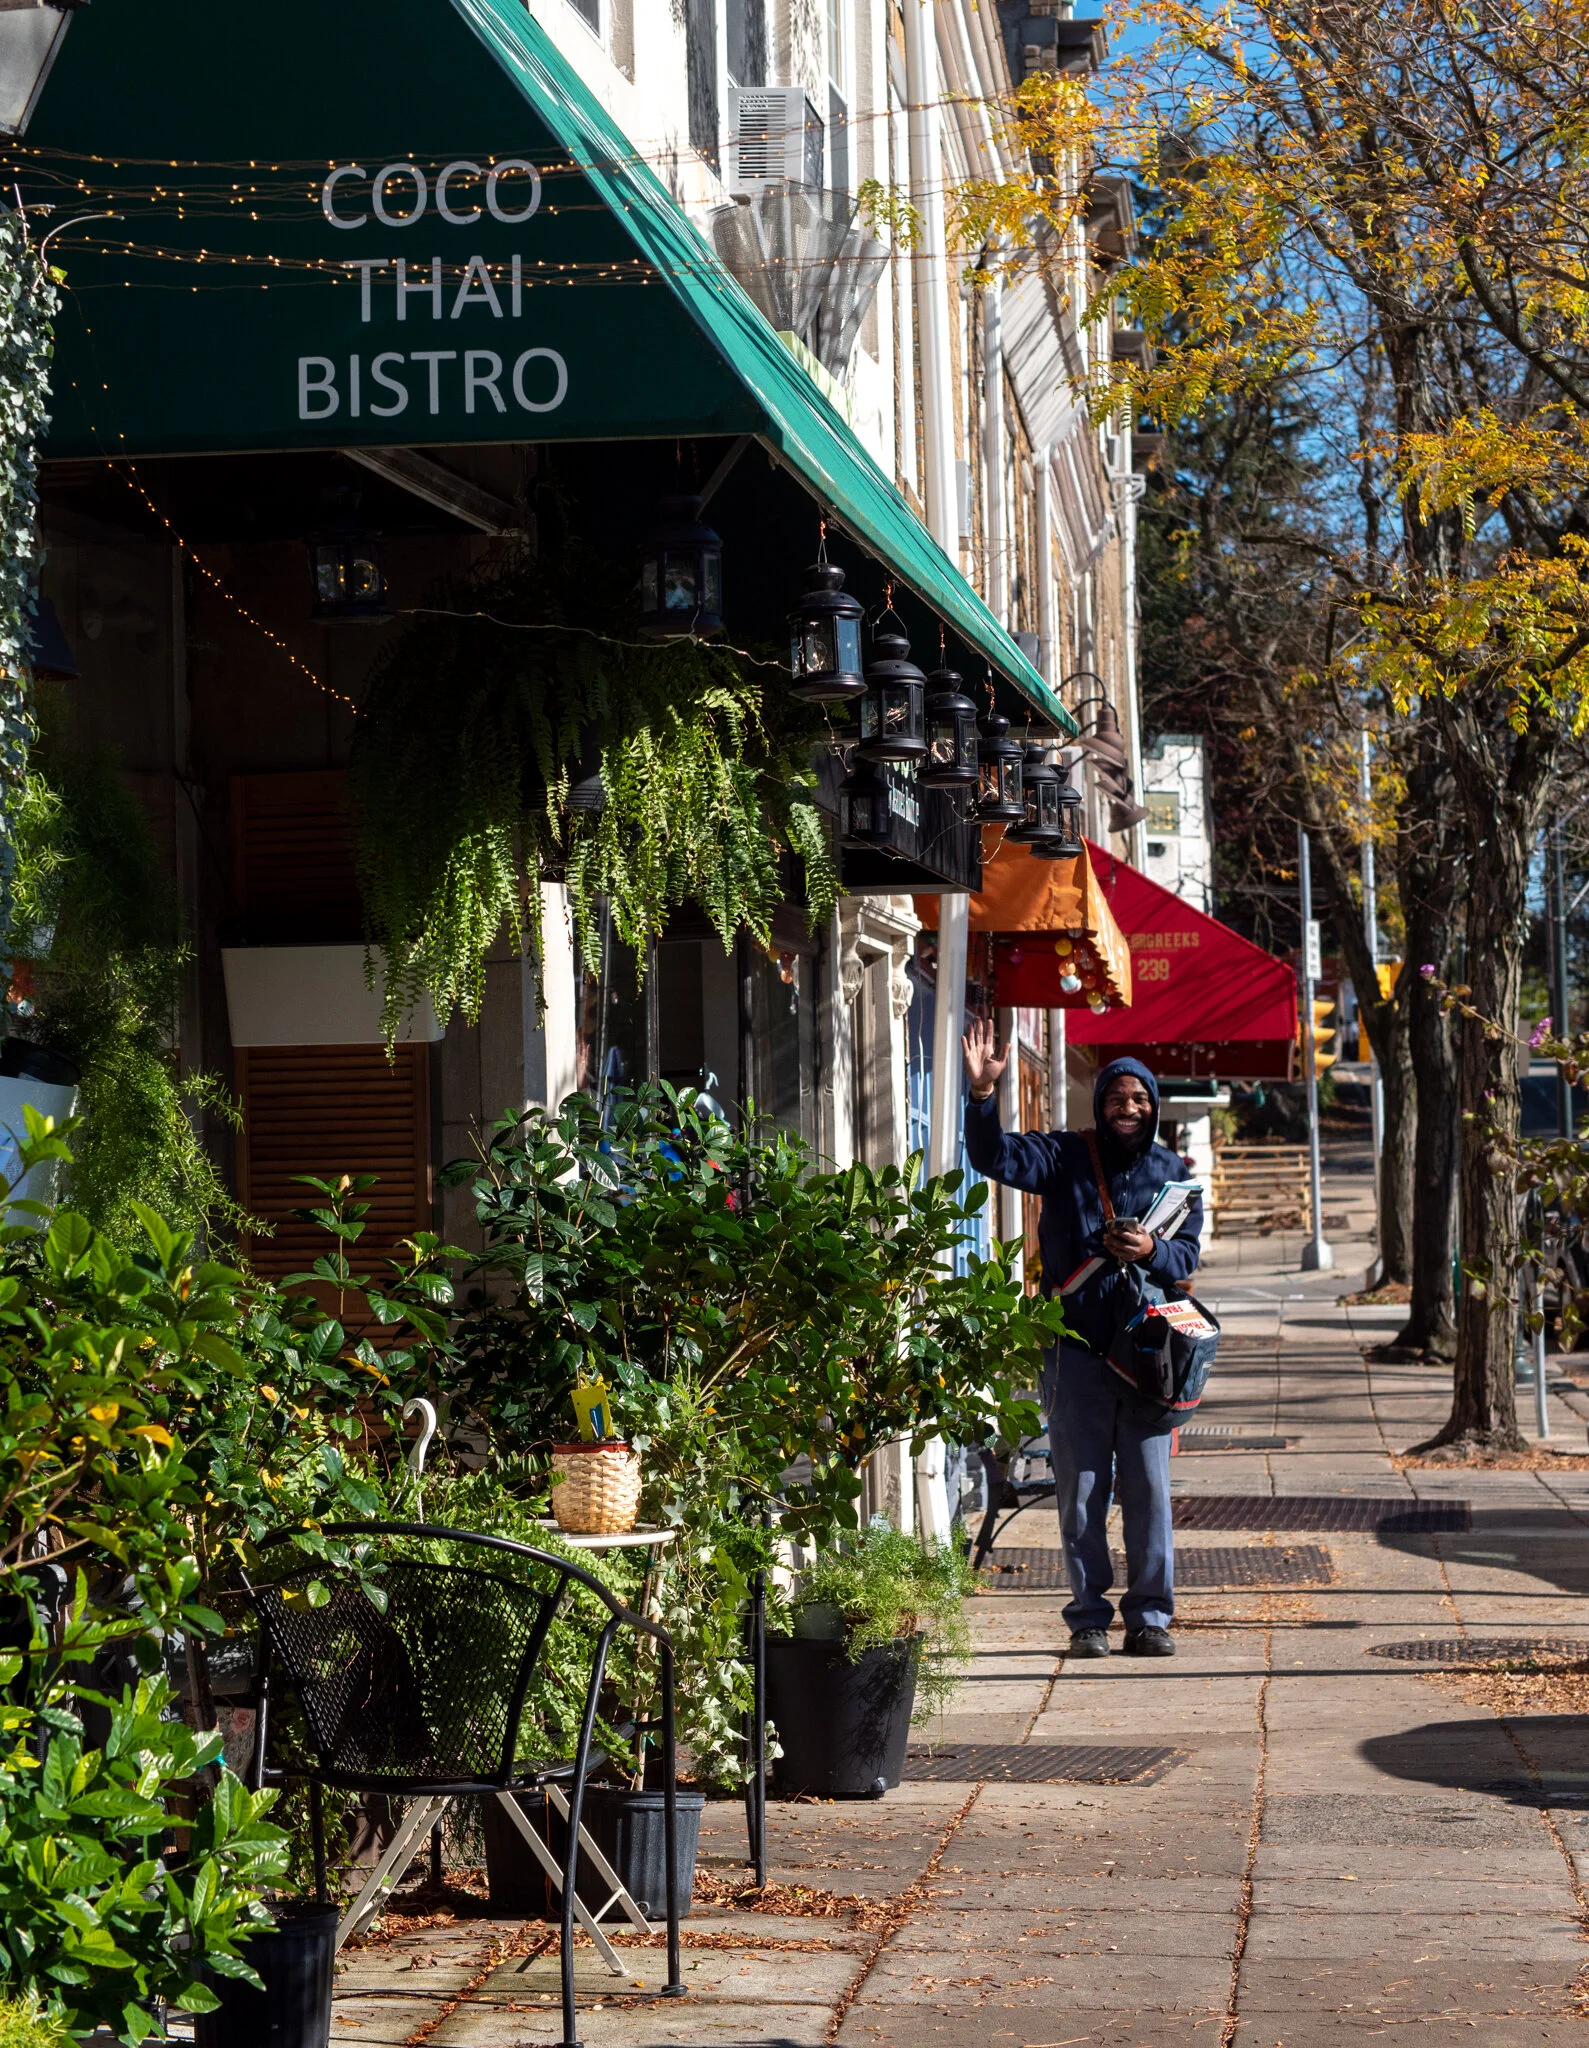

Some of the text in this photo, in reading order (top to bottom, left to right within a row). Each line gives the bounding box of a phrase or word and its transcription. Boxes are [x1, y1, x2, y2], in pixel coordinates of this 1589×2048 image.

[322, 159, 542, 229] COCO
[343, 254, 522, 322] THAI
[298, 347, 569, 420] BISTRO
[1137, 957, 1169, 981] 239
